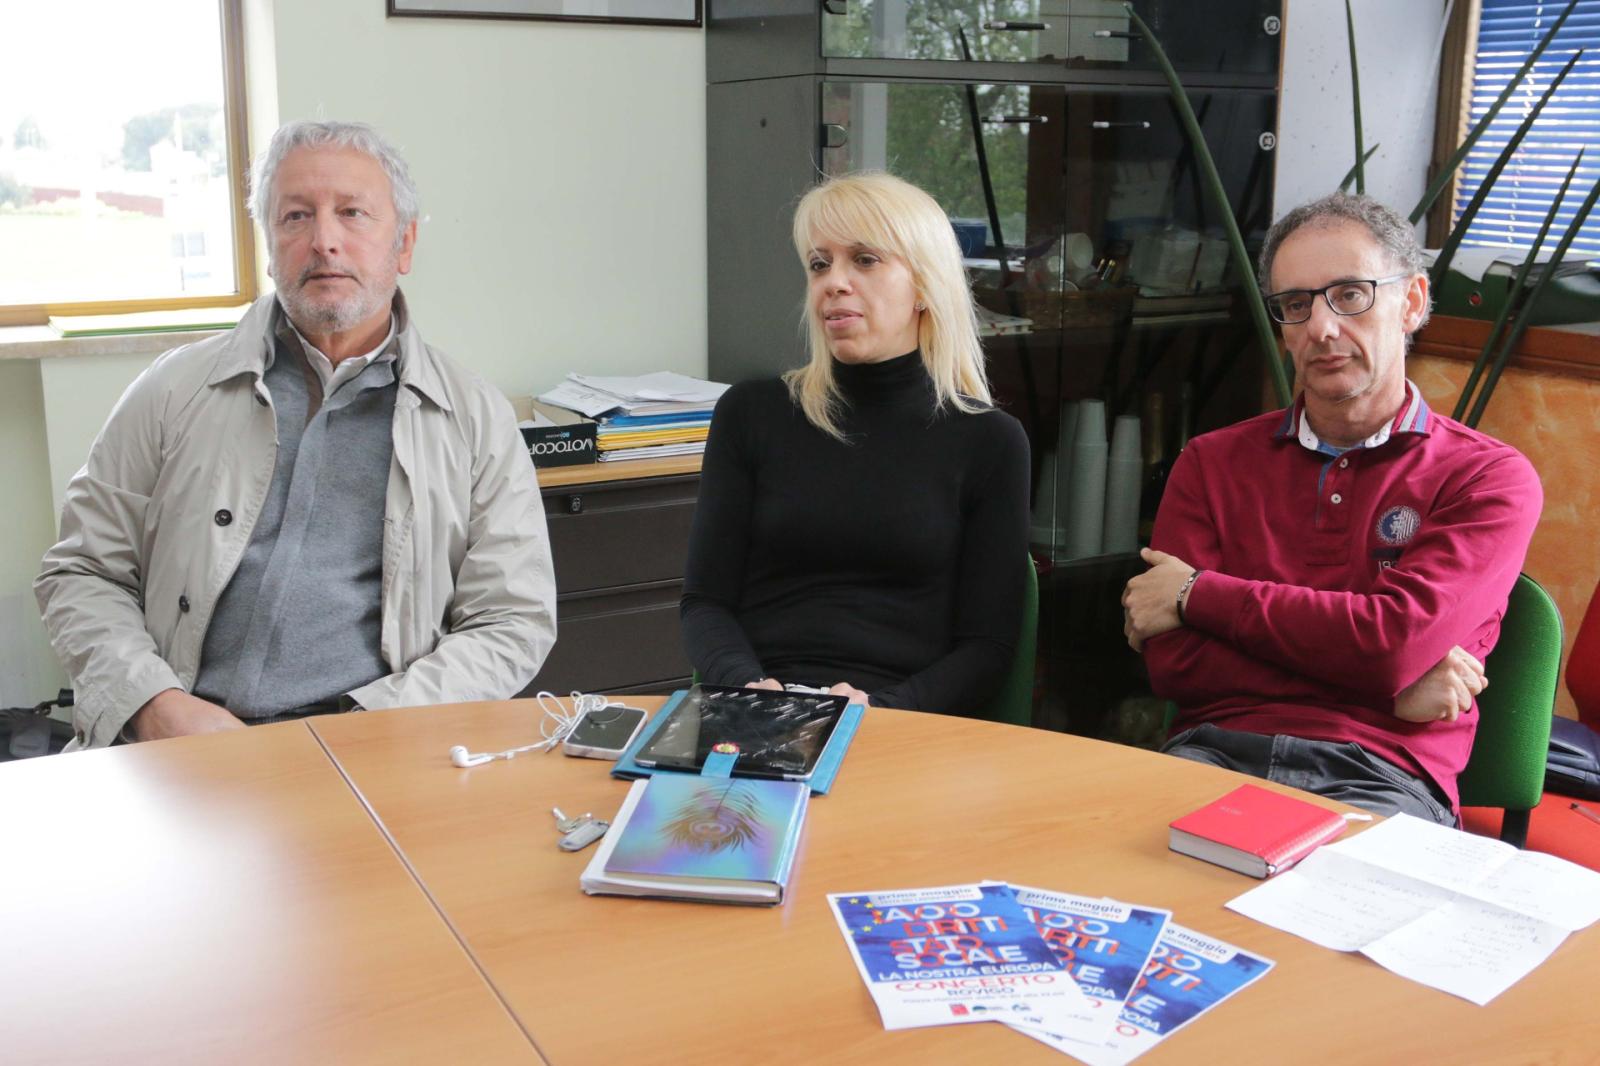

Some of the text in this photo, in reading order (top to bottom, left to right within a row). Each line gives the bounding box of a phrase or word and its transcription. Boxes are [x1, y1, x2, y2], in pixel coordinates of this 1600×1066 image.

[1026, 892, 1123, 914] primo maggio
[1178, 932, 1228, 955] maggio
[878, 971, 903, 981] LA
[906, 966, 981, 979] NOSTRA
[988, 962, 1057, 975] EUROPA
[895, 974, 1056, 992] CONCERTO
[946, 986, 1015, 997] ROVIGO
[1080, 984, 1116, 999] OPA
